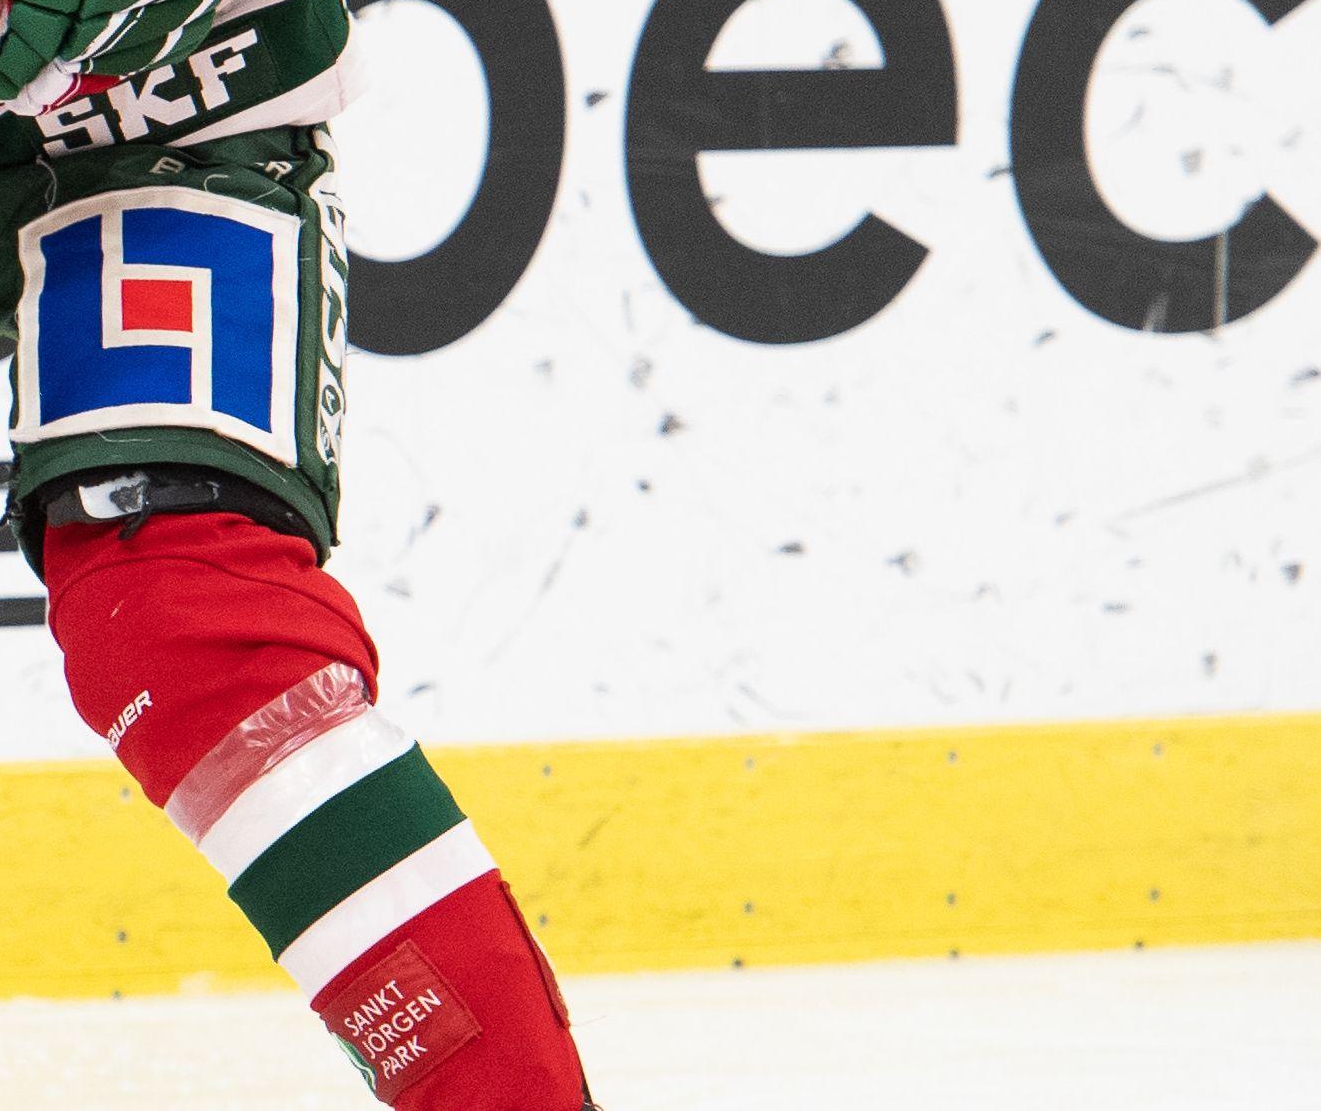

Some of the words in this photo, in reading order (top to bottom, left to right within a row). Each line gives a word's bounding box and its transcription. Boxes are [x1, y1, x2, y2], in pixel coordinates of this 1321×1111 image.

[35, 27, 259, 159] SKF
[106, 690, 154, 752] AUER
[343, 980, 405, 1037] SANKT
[361, 988, 443, 1060] JÖRGEN
[380, 1034, 428, 1080] PARK
